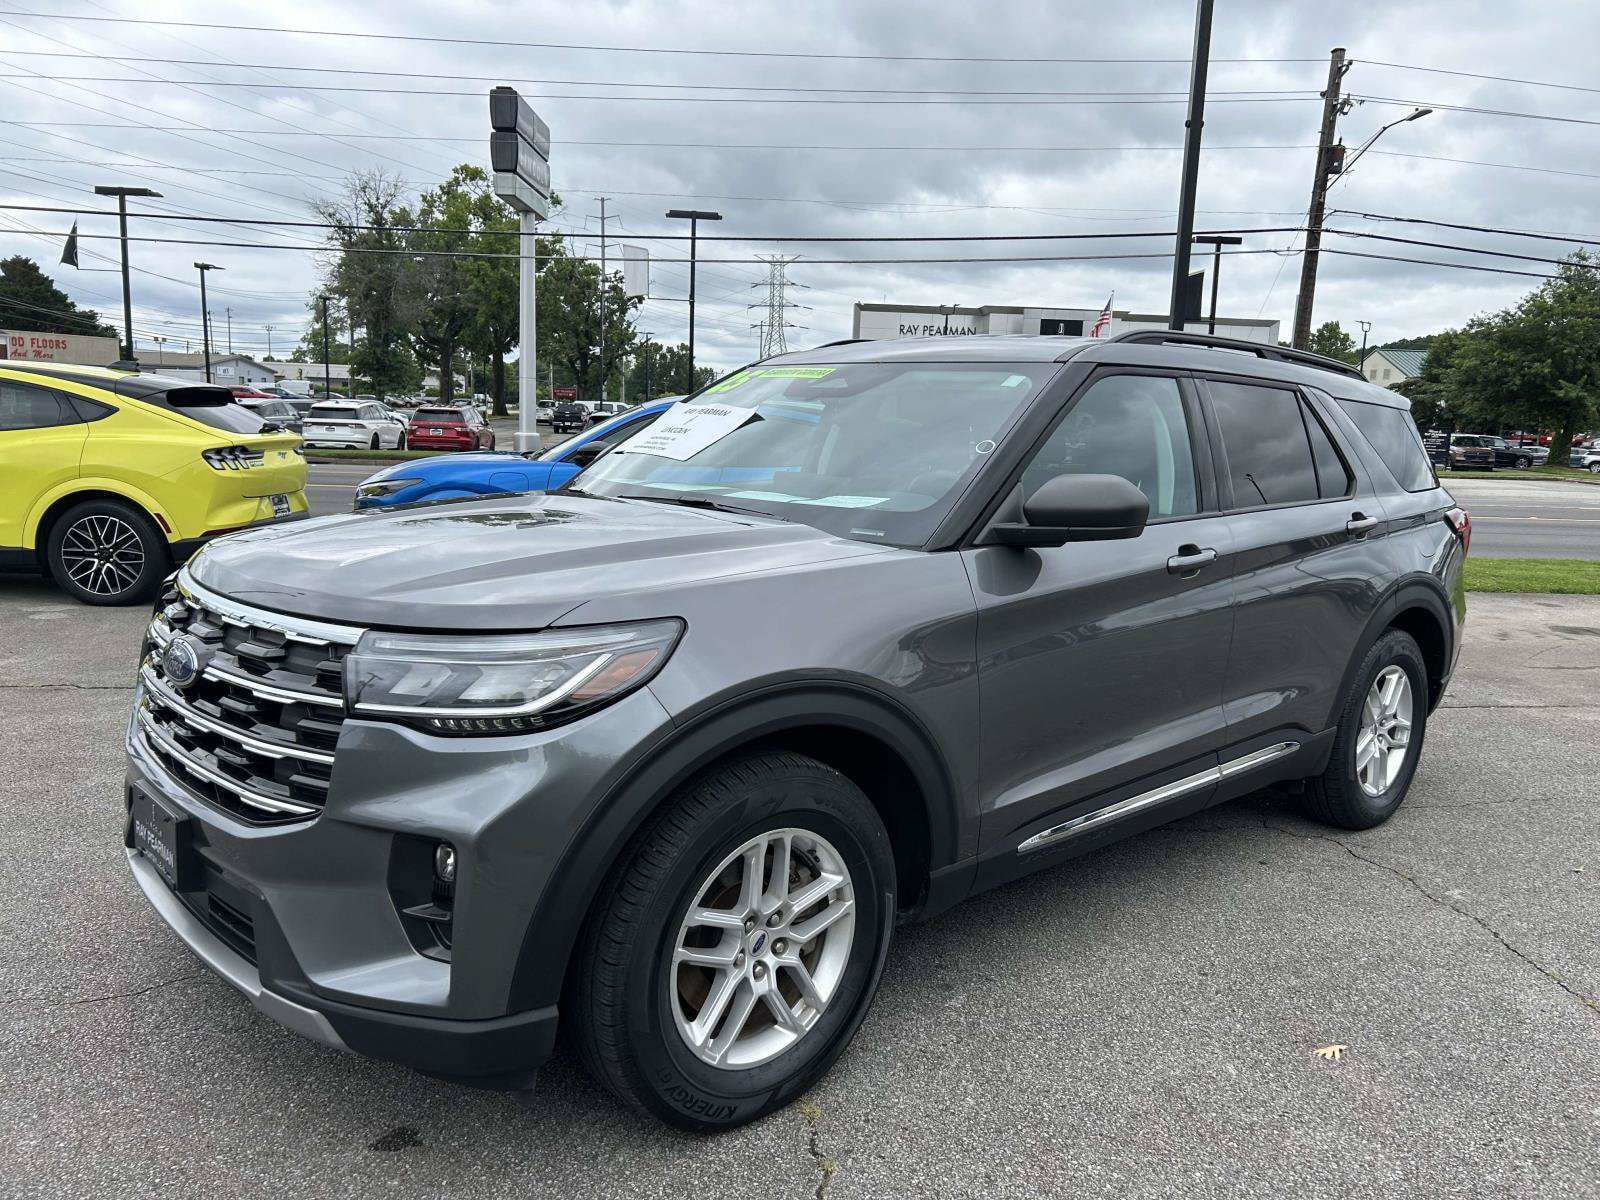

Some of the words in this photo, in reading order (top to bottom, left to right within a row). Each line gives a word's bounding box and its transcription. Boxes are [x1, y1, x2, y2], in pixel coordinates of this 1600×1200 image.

[899, 325, 920, 336] RAY
[30, 337, 68, 350] FLOORS
[10, 348, 28, 358] And
[32, 349, 54, 359] More
[135, 819, 147, 841] RAY
[147, 829, 174, 869] PEARMAN
